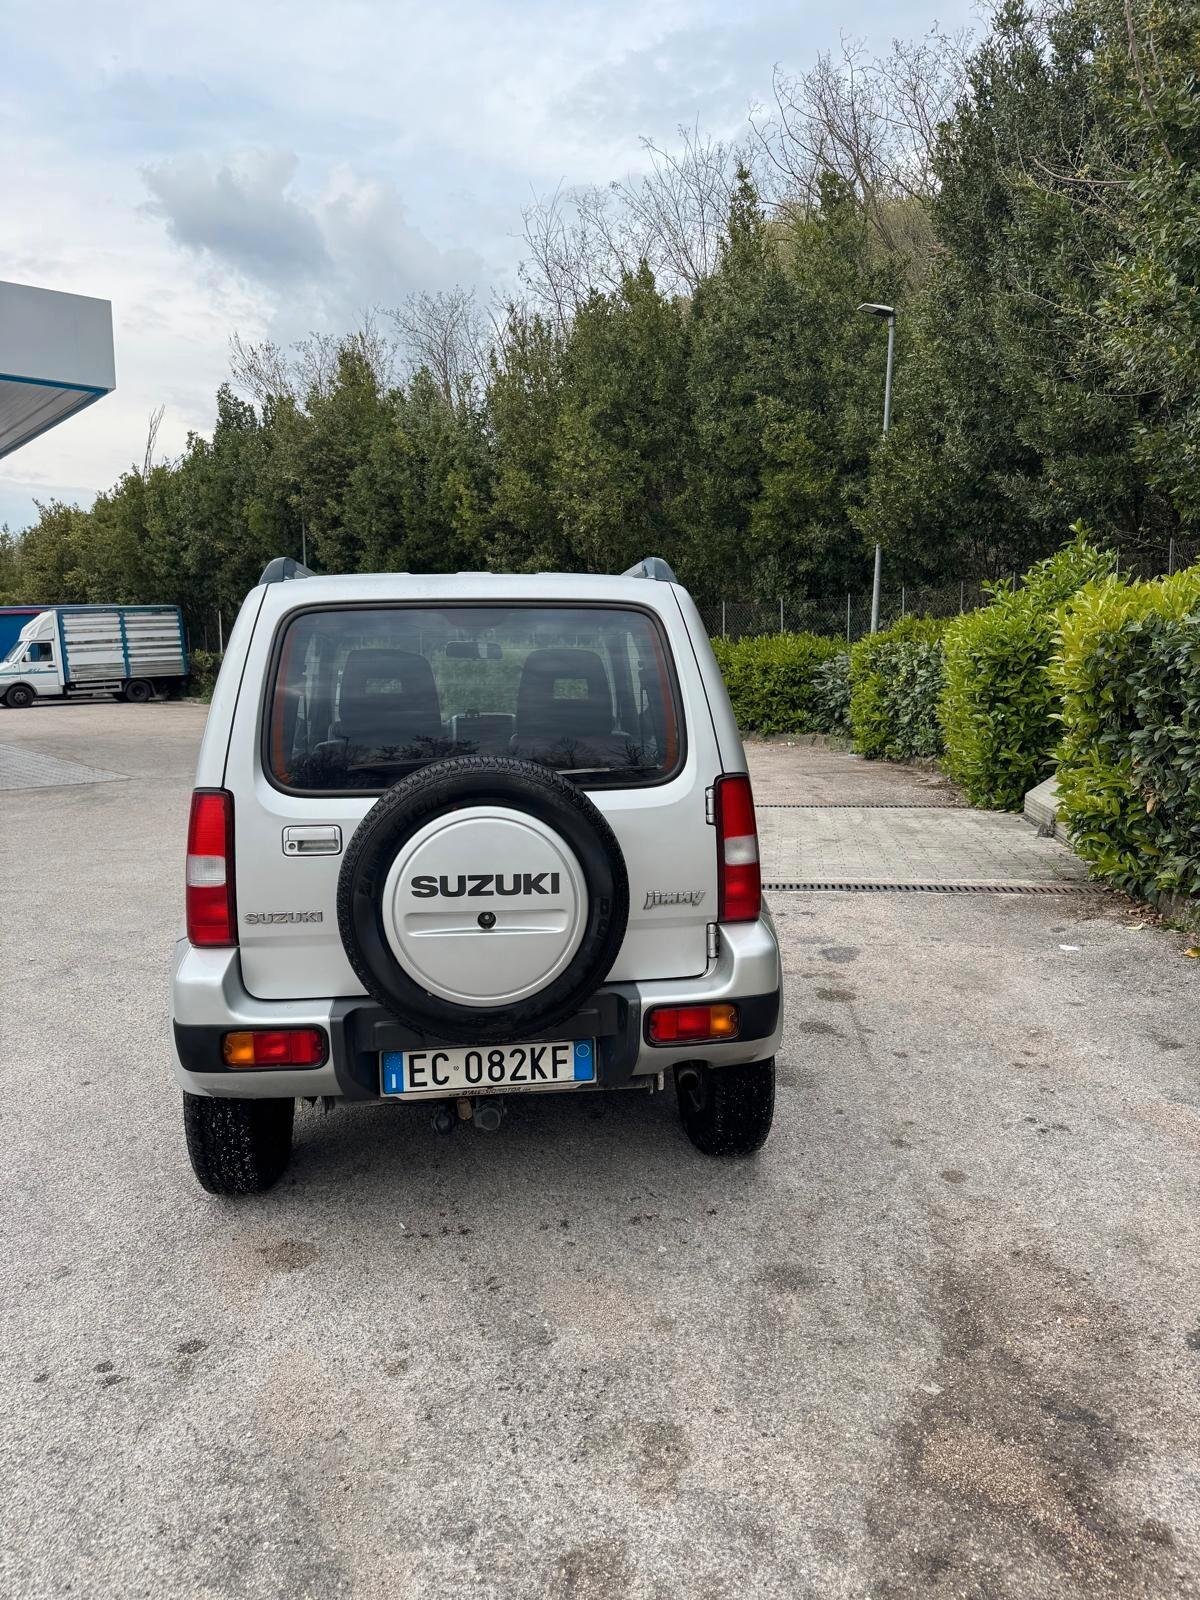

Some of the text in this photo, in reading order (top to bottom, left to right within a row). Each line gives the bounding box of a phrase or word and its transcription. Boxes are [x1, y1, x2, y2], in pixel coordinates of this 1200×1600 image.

[410, 872, 561, 898] SUZUKI
[244, 910, 324, 925] SUZUKI
[408, 1045, 570, 1088] EC 082KF
